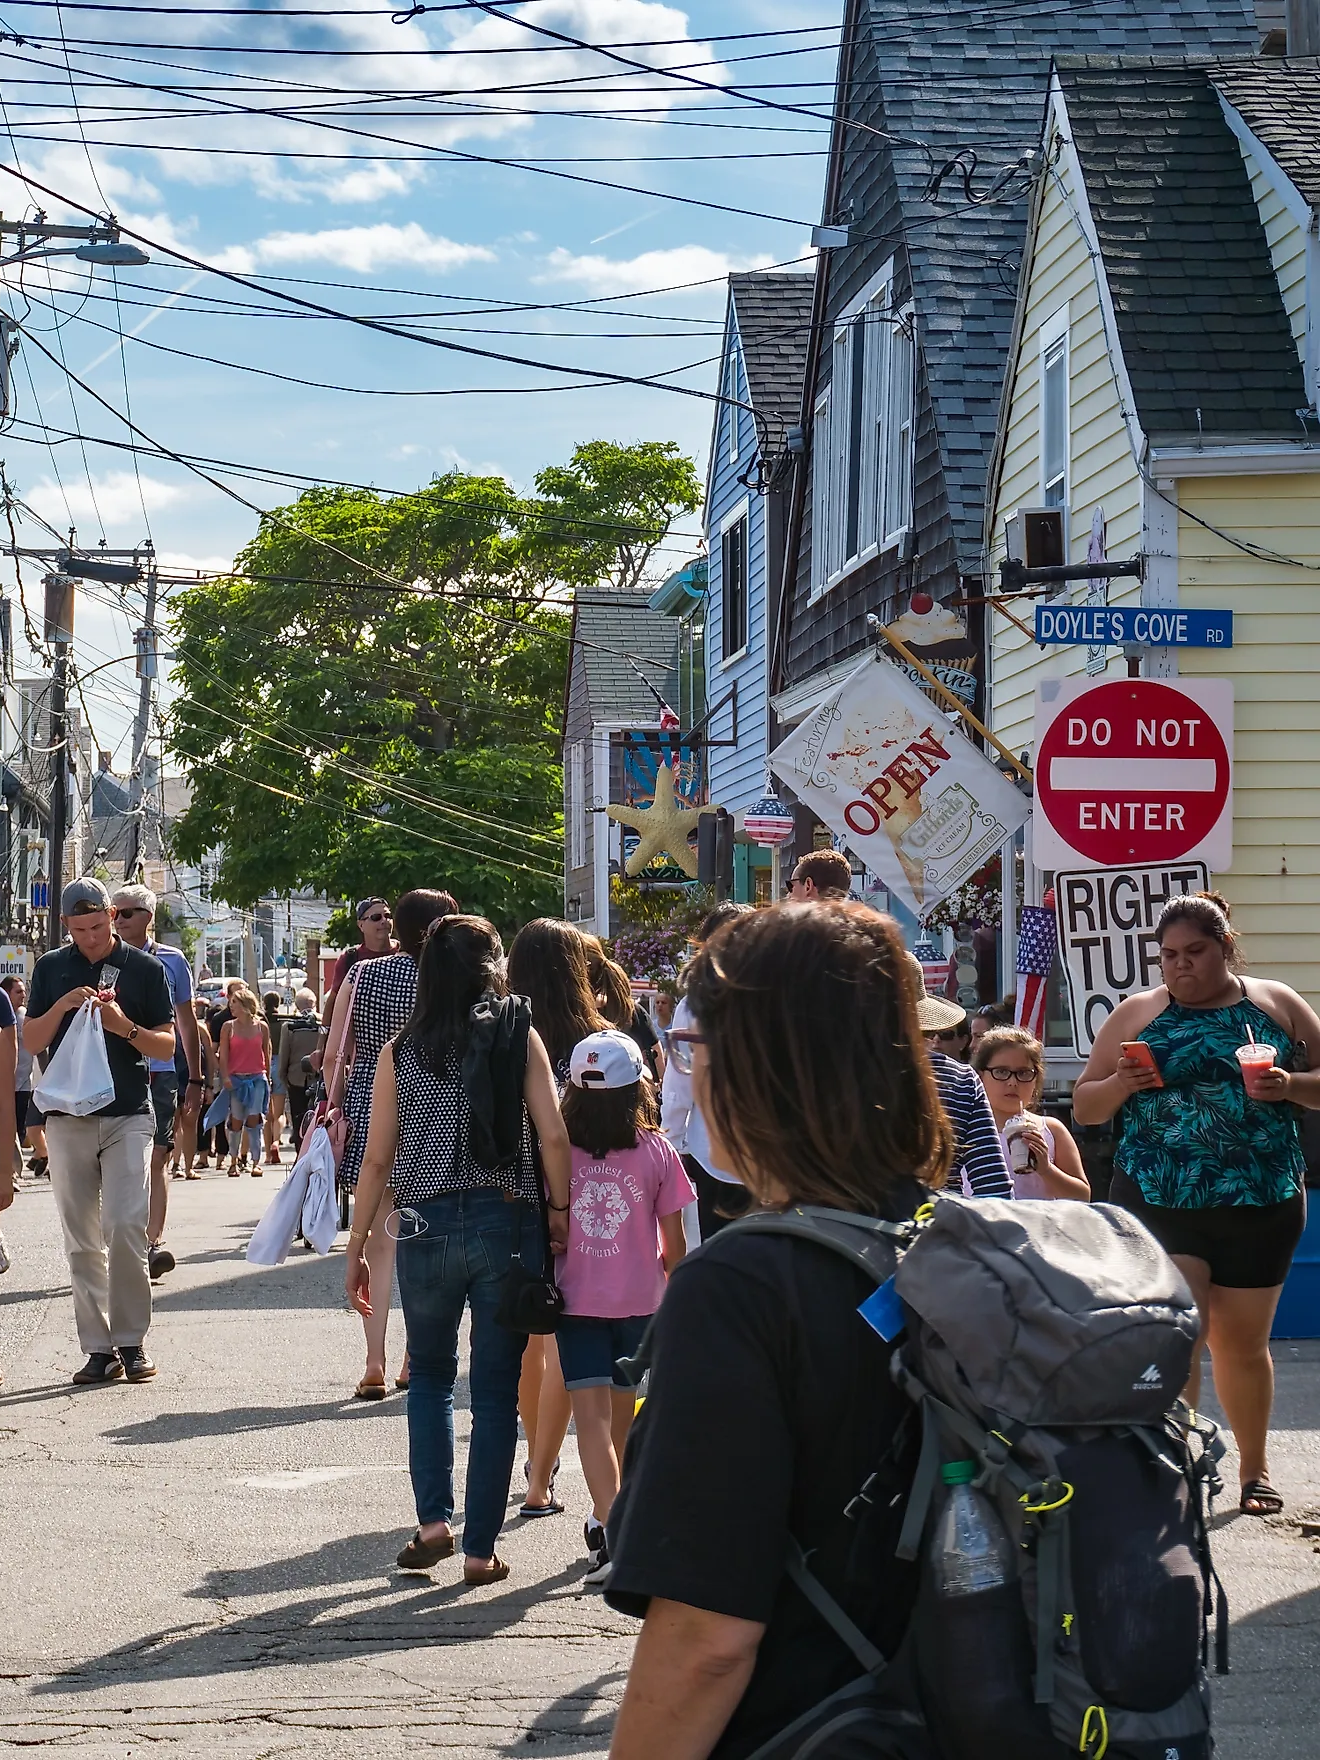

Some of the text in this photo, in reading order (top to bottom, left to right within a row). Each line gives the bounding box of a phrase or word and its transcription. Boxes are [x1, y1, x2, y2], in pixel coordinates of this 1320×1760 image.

[1041, 611, 1224, 643] DOYLE'S COVE RD
[794, 693, 843, 776] Featuring
[1068, 718, 1201, 747] DO NOT
[844, 727, 952, 836] OPEN
[1079, 803, 1185, 831] ENTER
[944, 822, 967, 844] CREAM
[1066, 870, 1198, 933] RIGHT
[1070, 933, 1162, 991] TUR
[579, 1163, 622, 1178] Coolest
[575, 1240, 620, 1258] Around
